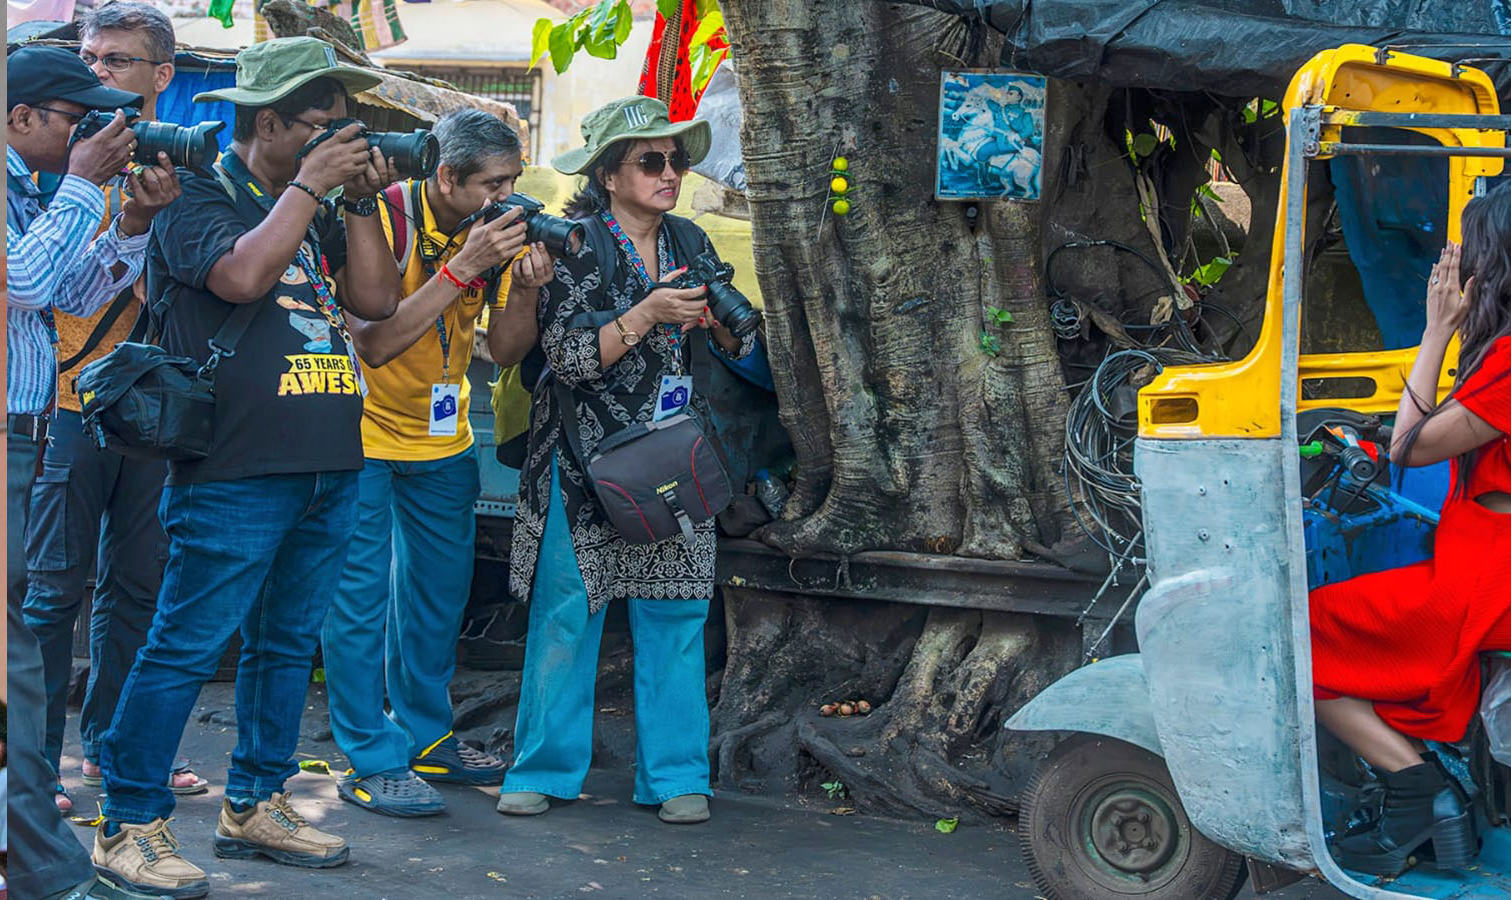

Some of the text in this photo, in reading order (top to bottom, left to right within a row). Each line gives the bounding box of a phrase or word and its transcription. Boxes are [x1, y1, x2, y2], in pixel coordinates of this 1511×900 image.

[295, 358, 312, 370] 65
[313, 358, 345, 371] YEARS
[278, 372, 361, 396] AWES
